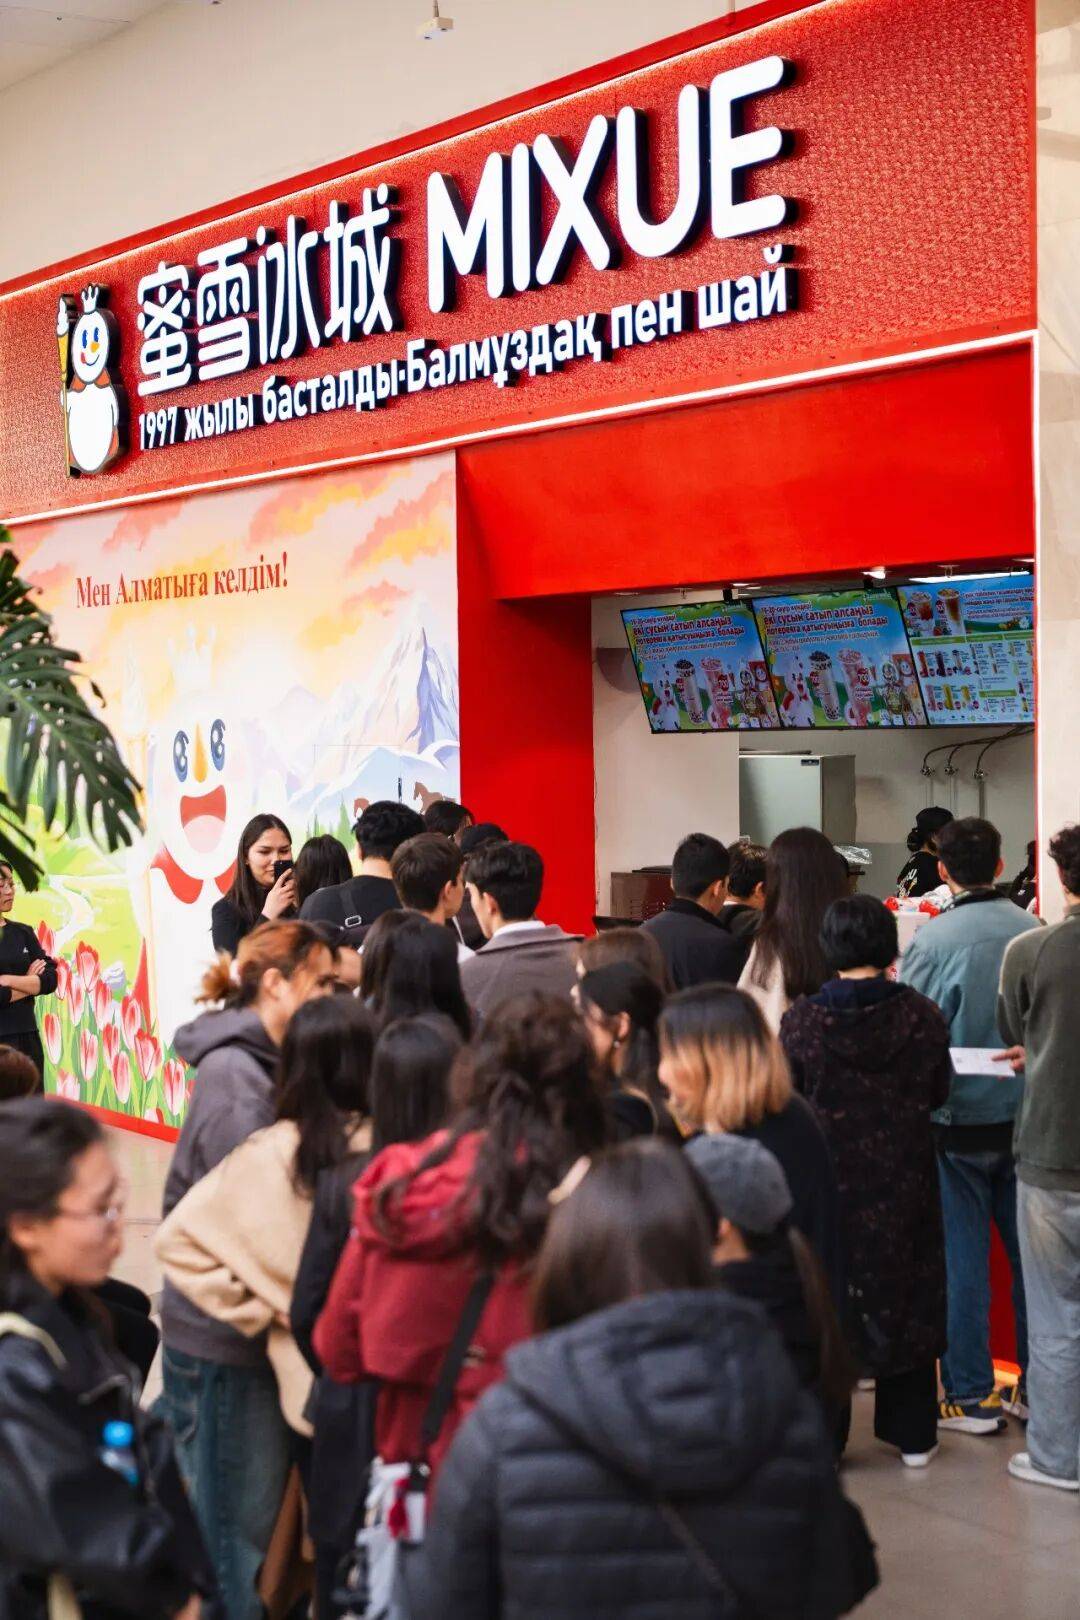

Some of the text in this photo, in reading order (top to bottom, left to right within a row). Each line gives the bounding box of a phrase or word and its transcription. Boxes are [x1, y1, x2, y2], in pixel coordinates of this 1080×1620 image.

[136, 55, 787, 396] 蜜雪冰城 MIXUE
[138, 405, 178, 450] 1997
[185, 393, 254, 442] жылы
[611, 289, 683, 349] пен
[698, 243, 787, 330] шай
[76, 551, 288, 608] Мен Алматыға келдім!
